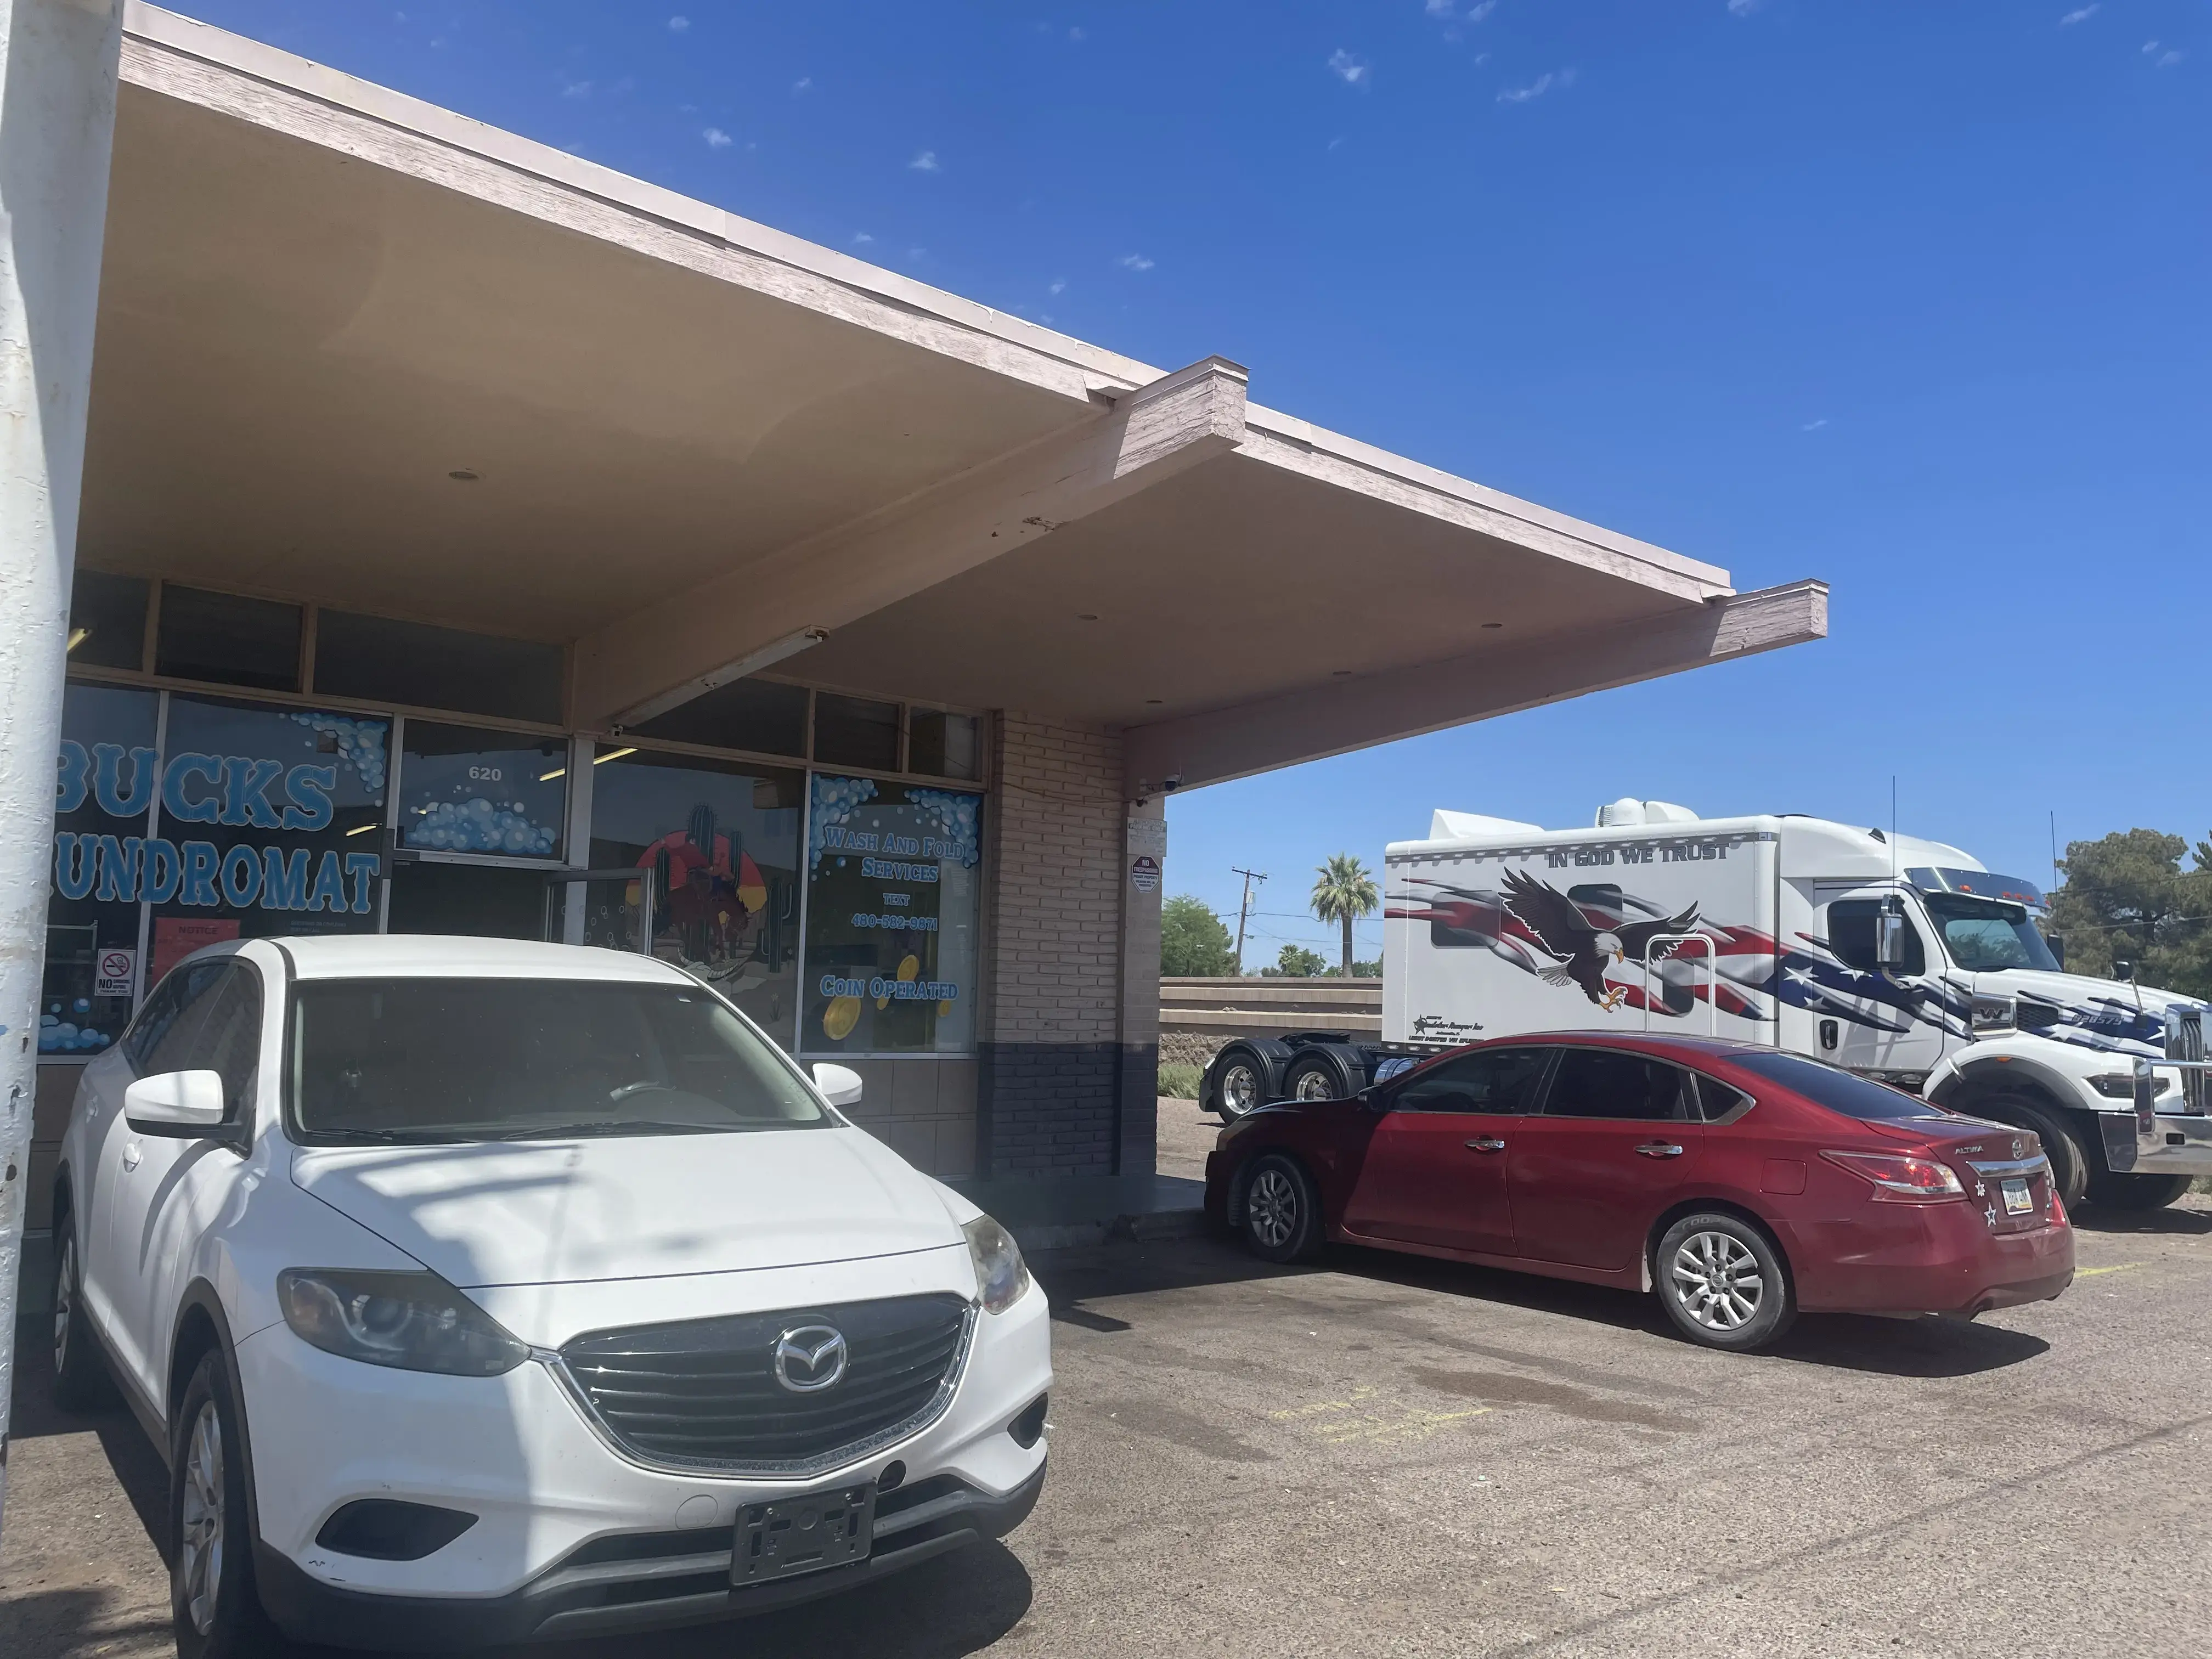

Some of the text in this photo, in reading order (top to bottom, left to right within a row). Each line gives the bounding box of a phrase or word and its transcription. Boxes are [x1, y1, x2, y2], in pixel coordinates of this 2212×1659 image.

[469, 766, 501, 781] 620
[55, 739, 337, 832] BUCKS
[1548, 843, 1730, 868] IN GOD WE TRUST
[52, 831, 380, 914] UNDROMAT
[862, 857, 939, 883] SERVICES
[883, 893, 911, 906] TEXT
[178, 926, 218, 935] NOTICE
[851, 913, 938, 932] 480-582-9871
[99, 979, 112, 989] NO
[820, 974, 959, 1001] COIN OPERATED
[1955, 1145, 1984, 1155] ALTIMA
